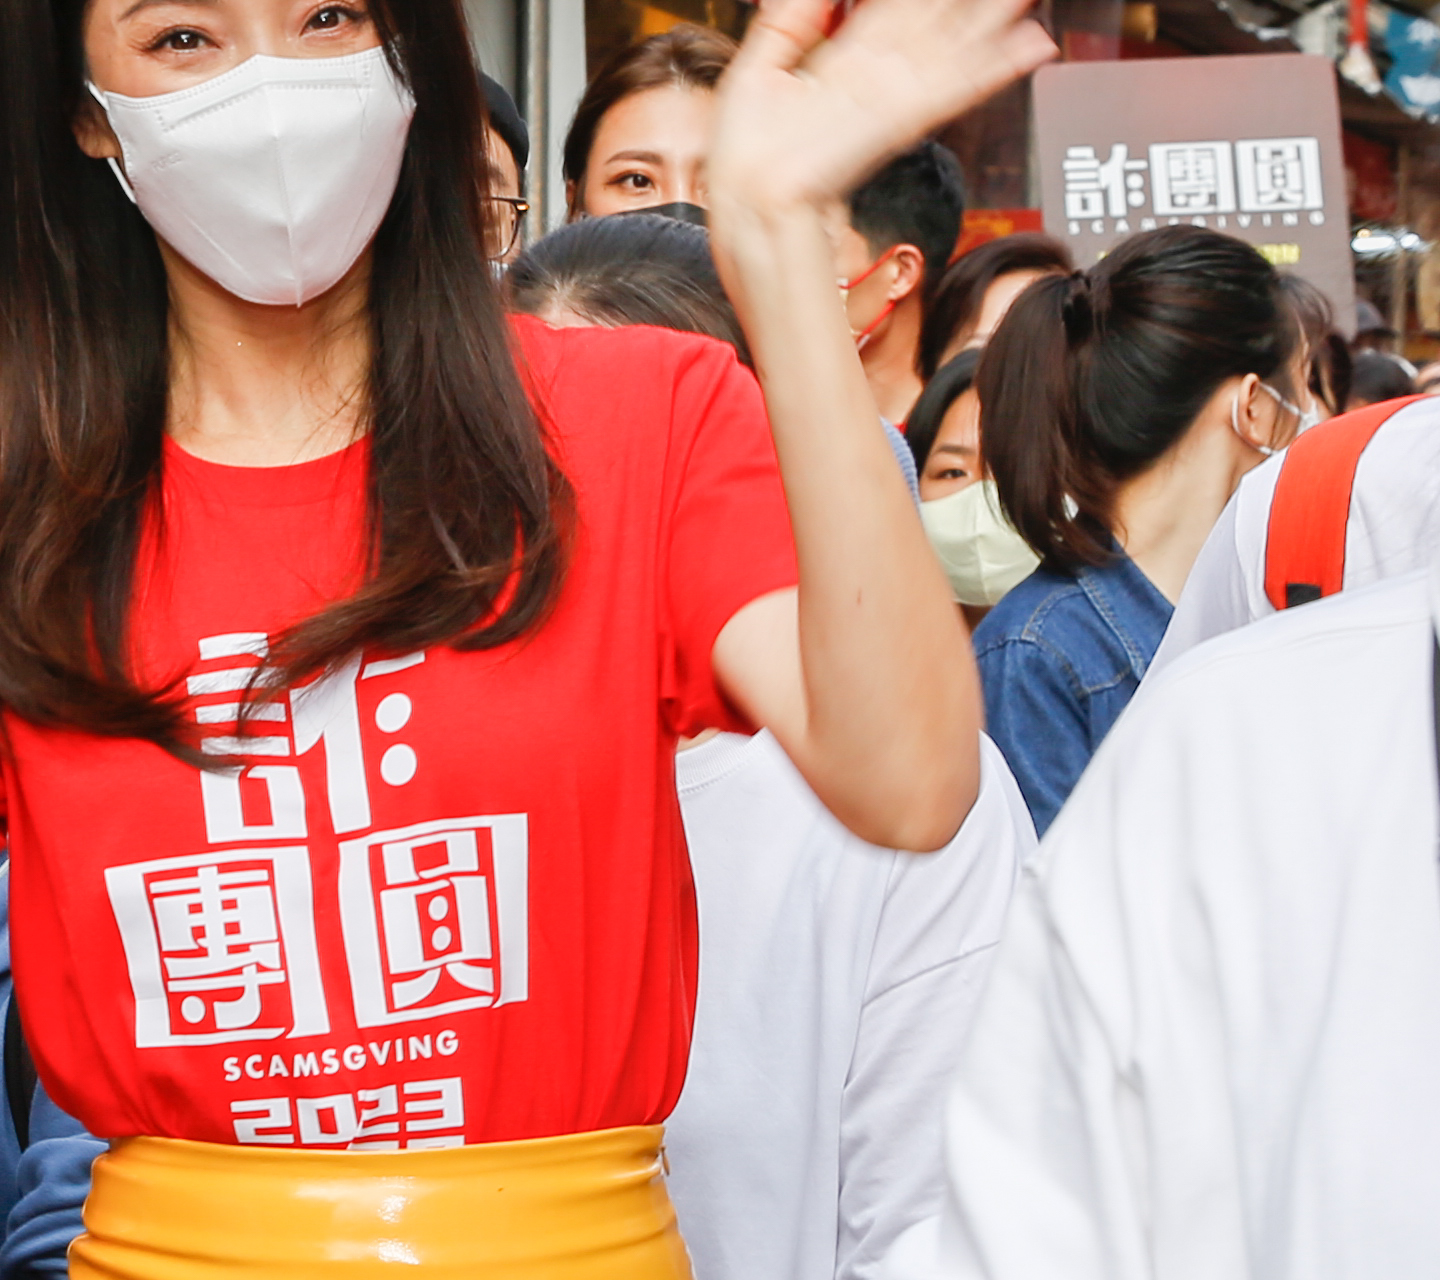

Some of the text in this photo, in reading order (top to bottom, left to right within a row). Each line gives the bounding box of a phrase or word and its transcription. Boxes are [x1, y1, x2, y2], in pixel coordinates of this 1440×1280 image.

[1062, 137, 1324, 219] 詐團圓
[104, 812, 529, 1048] 團圓
